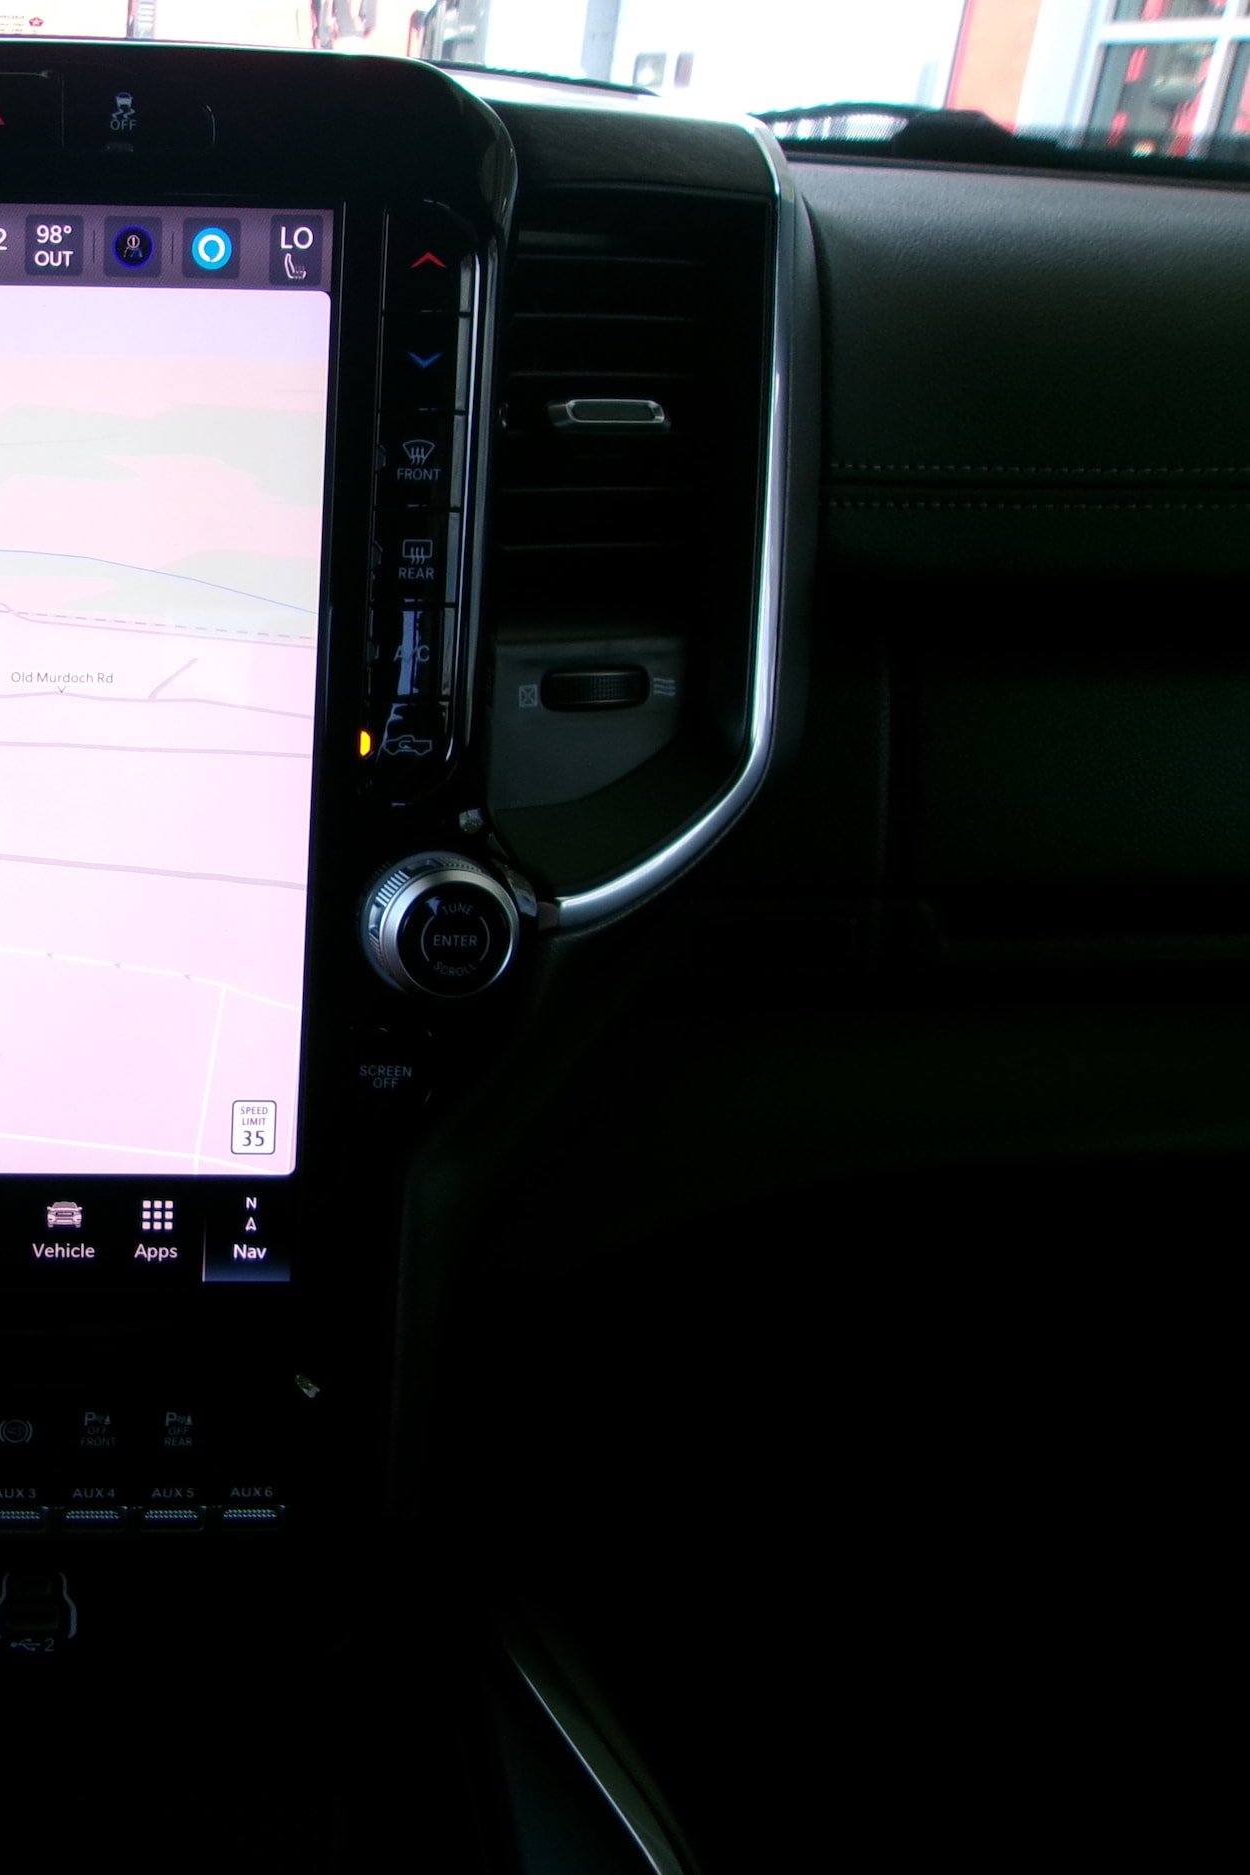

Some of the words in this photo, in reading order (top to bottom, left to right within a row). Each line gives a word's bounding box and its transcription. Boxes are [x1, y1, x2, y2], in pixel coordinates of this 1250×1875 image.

[109, 119, 137, 131] OFF
[36, 224, 73, 244] 98°
[280, 226, 314, 250] LO
[34, 250, 74, 268] OUT
[396, 468, 441, 481] FRONT
[398, 567, 435, 581] REAR
[10, 671, 33, 683] Old
[36, 671, 94, 684] Murdoch
[97, 672, 114, 684] Rd
[441, 902, 475, 916] TUNE
[432, 934, 479, 947] ENTER
[432, 959, 479, 978] SCROLL
[358, 1064, 413, 1078] SCREEN
[372, 1077, 400, 1089] OFF
[240, 1106, 269, 1115] SPEED
[241, 1117, 267, 1126] LIMIT
[241, 1129, 266, 1147] 35
[32, 1242, 96, 1259] Vehicle
[133, 1243, 178, 1262] Apps
[232, 1243, 267, 1260] Nav
[80, 1437, 116, 1447] FRONT
[163, 1436, 193, 1447] REAR
[28, 1487, 37, 1499] 3
[71, 1487, 105, 1499] AUX
[106, 1487, 116, 1499] 4
[151, 1487, 185, 1499] AUX
[187, 1487, 195, 1499] 5
[229, 1486, 263, 1498] AUX
[264, 1486, 273, 1498] 6
[43, 1639, 55, 1653] 2
